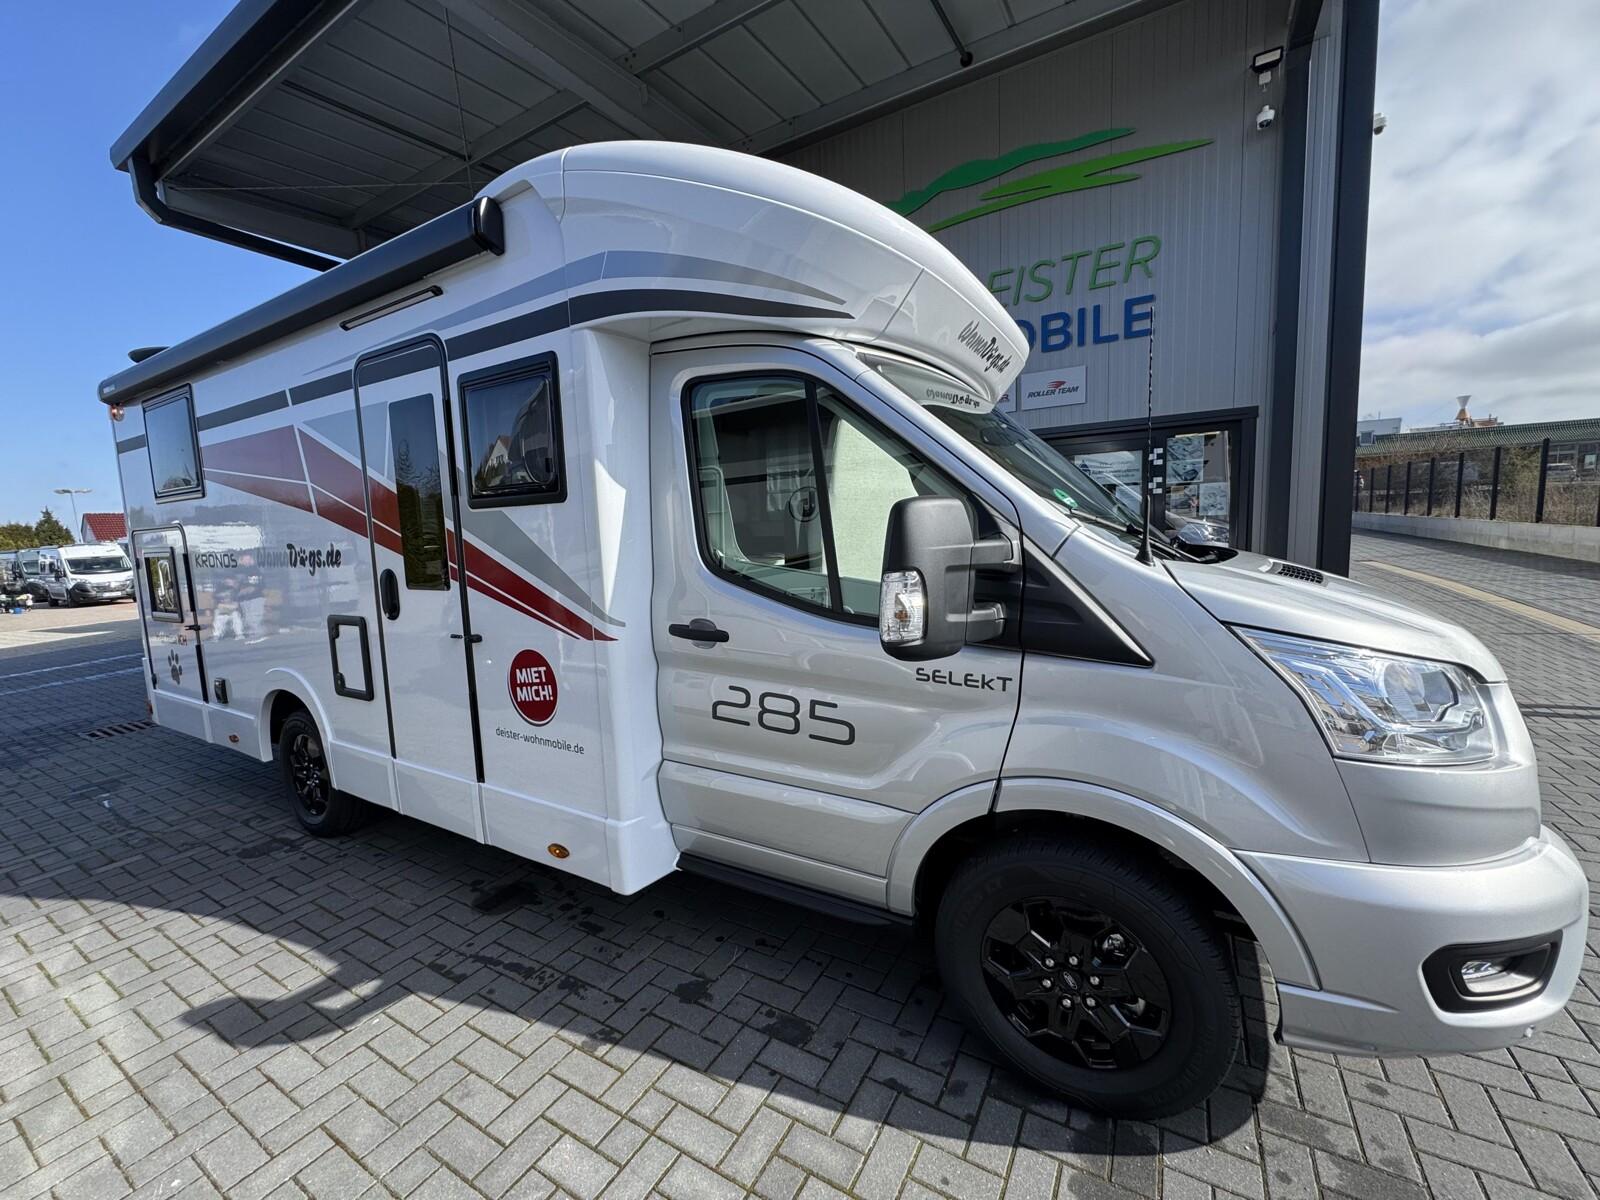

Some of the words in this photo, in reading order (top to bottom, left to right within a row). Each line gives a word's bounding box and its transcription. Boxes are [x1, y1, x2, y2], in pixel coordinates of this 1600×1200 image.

[1027, 388, 1057, 399] ROLLER
[1058, 385, 1080, 395] TEAM
[194, 552, 238, 568] KRONOS
[515, 666, 547, 684] MIET
[915, 667, 1013, 692] SELEKT
[516, 685, 554, 702] MICH!
[711, 685, 856, 746] 285
[495, 726, 585, 754] deister-wohnmobile.de
